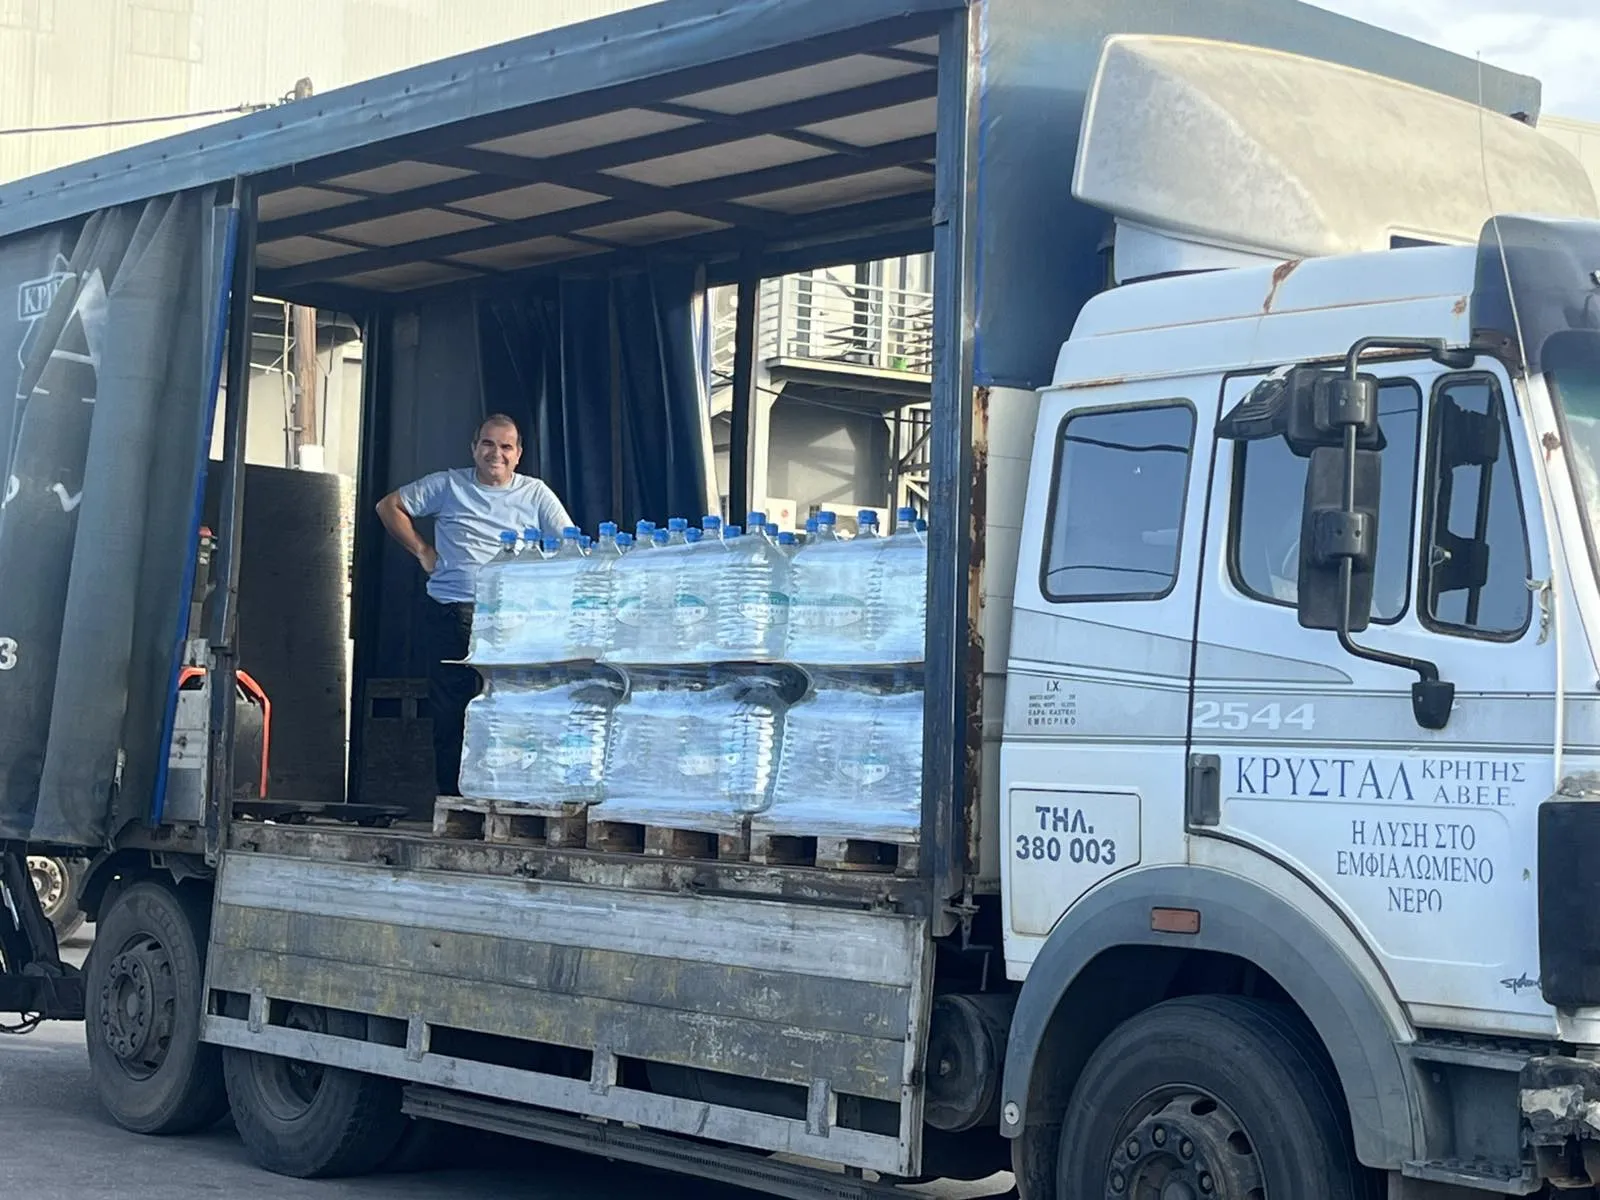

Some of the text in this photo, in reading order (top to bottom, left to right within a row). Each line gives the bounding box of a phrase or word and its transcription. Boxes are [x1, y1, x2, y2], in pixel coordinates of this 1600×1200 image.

[1192, 700, 1316, 731] 2544
[1236, 757, 1526, 800] ΚΡΥΣΤΑΛ ΚΡΗΤΗΣ
[1433, 785, 1516, 806] Α.Β.Ε.Ε.
[1035, 805, 1094, 834] ΤΗΛ.
[1016, 834, 1115, 865] 380 003
[1352, 820, 1475, 850] Η ΛΥΣΗ ΣΤΟ
[1336, 850, 1493, 884] ΕΜΦΙΑΛΩΜΕΝΟ
[1387, 886, 1442, 913] ΝΕΡΟ
